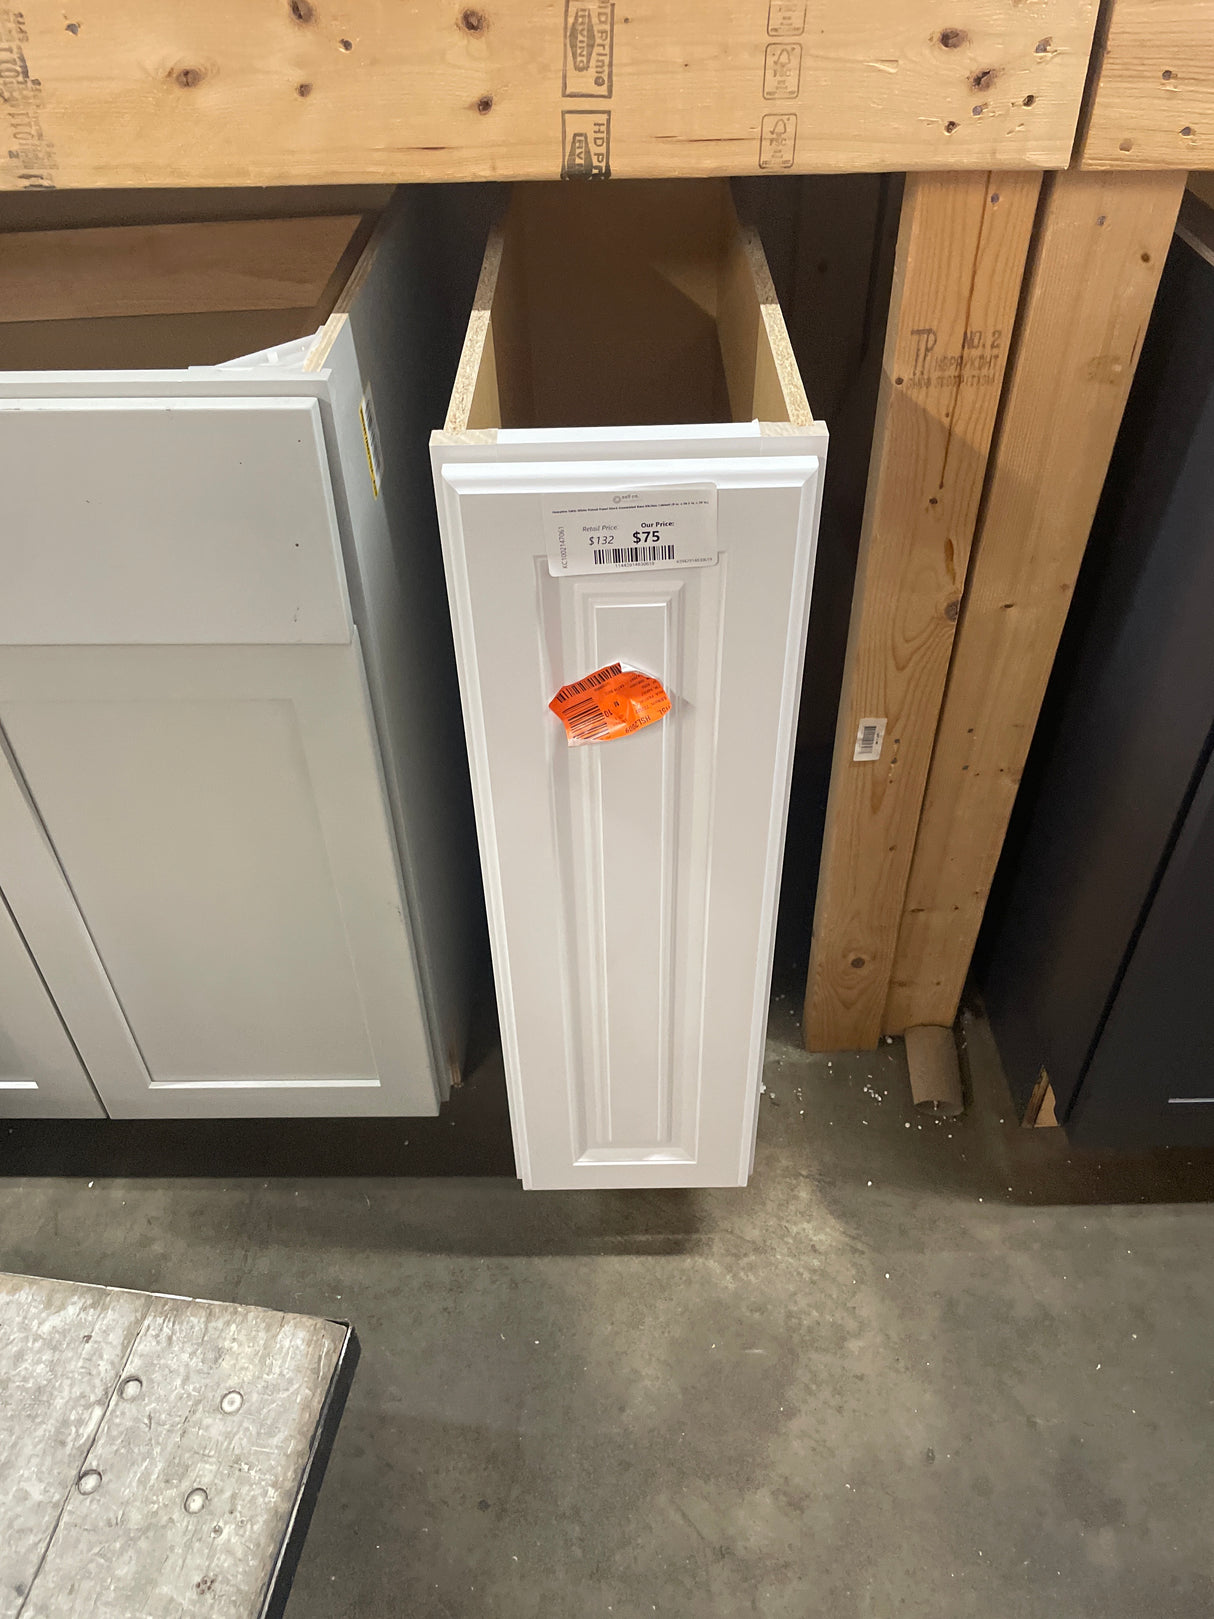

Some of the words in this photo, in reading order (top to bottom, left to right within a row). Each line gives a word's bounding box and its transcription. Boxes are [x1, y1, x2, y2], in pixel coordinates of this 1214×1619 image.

[577, 8, 588, 72] IRVING
[593, 122, 605, 147] HD
[589, 535, 615, 546] $132
[632, 530, 660, 544] $75
